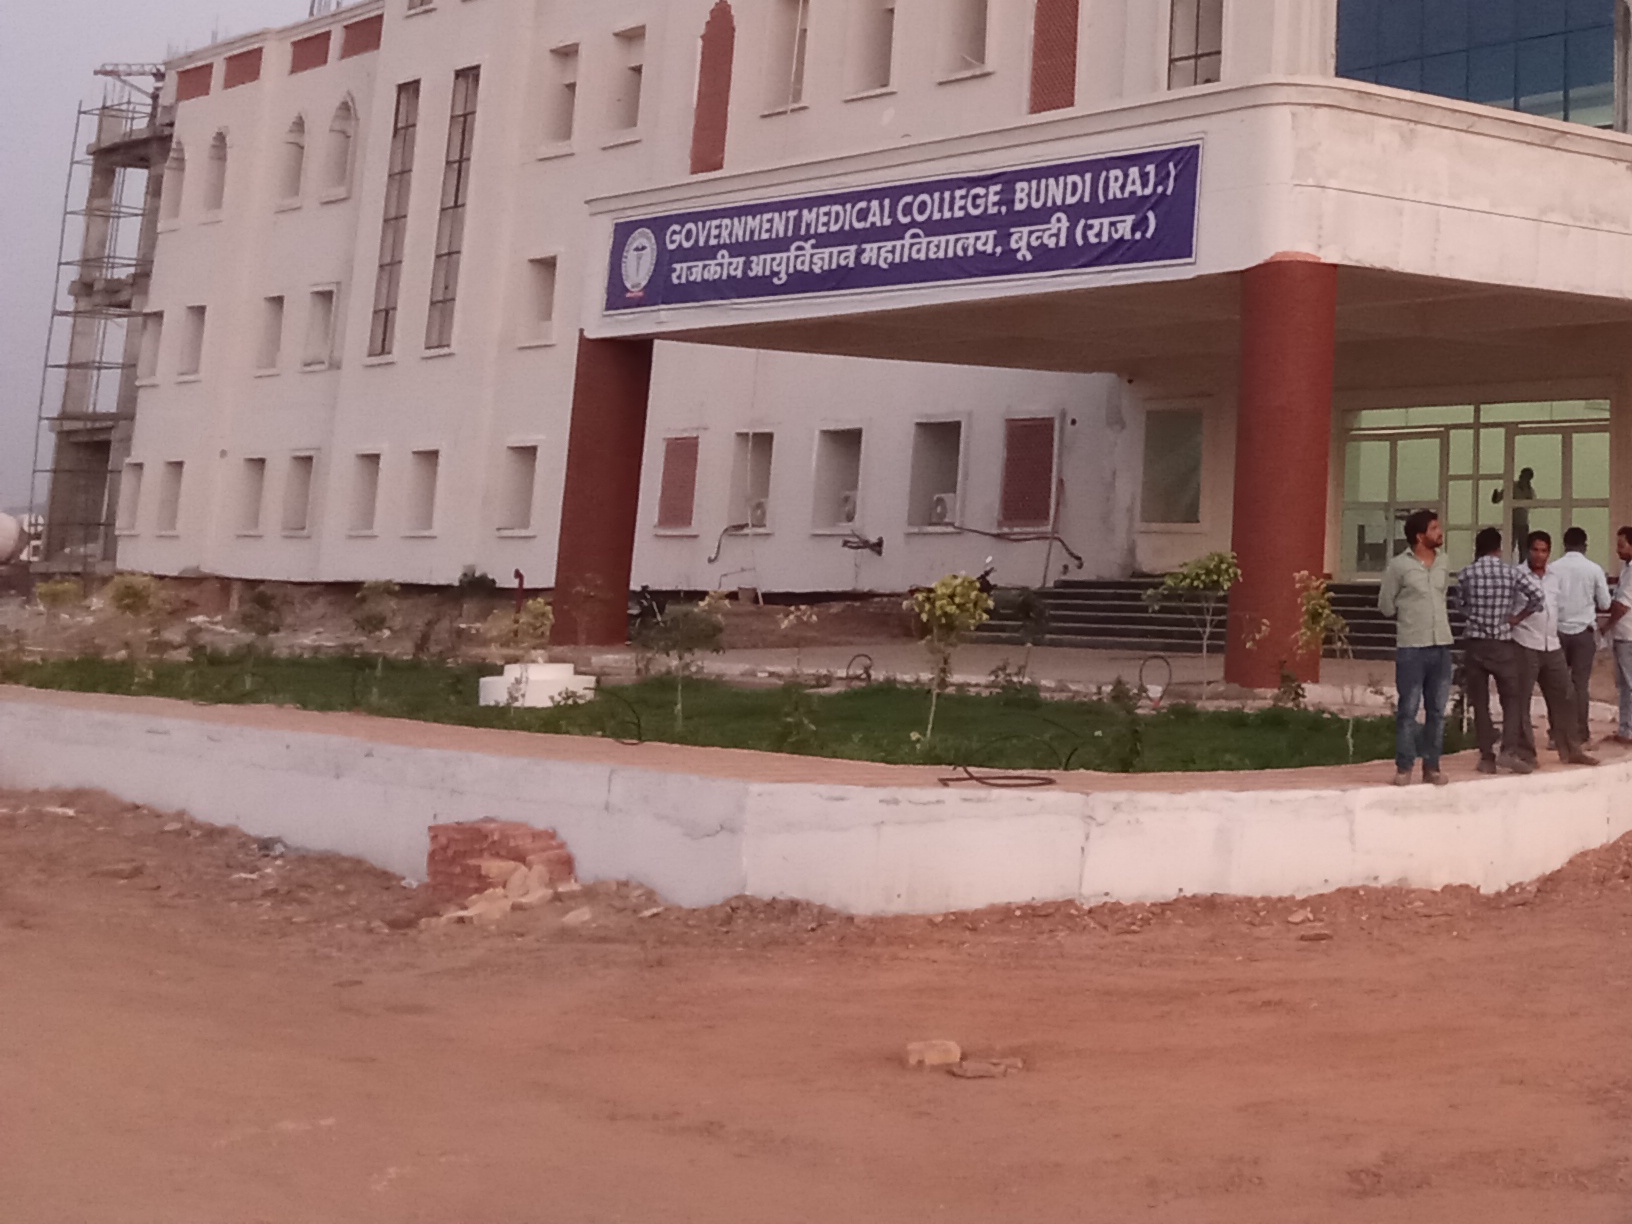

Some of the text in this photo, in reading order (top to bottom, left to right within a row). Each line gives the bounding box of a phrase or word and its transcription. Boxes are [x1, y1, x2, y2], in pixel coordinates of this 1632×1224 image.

[665, 161, 1176, 250] GOVERNMENT MEDICAL COLLEGE, BUNDI (RAJ.)
[671, 249, 746, 285] राजकीय
[747, 239, 857, 285] आयुर्विज्ञान
[860, 228, 1002, 269] महाविद्यालय,
[1009, 212, 1070, 262] बून्दी
[1075, 210, 1156, 247] (राज.)
